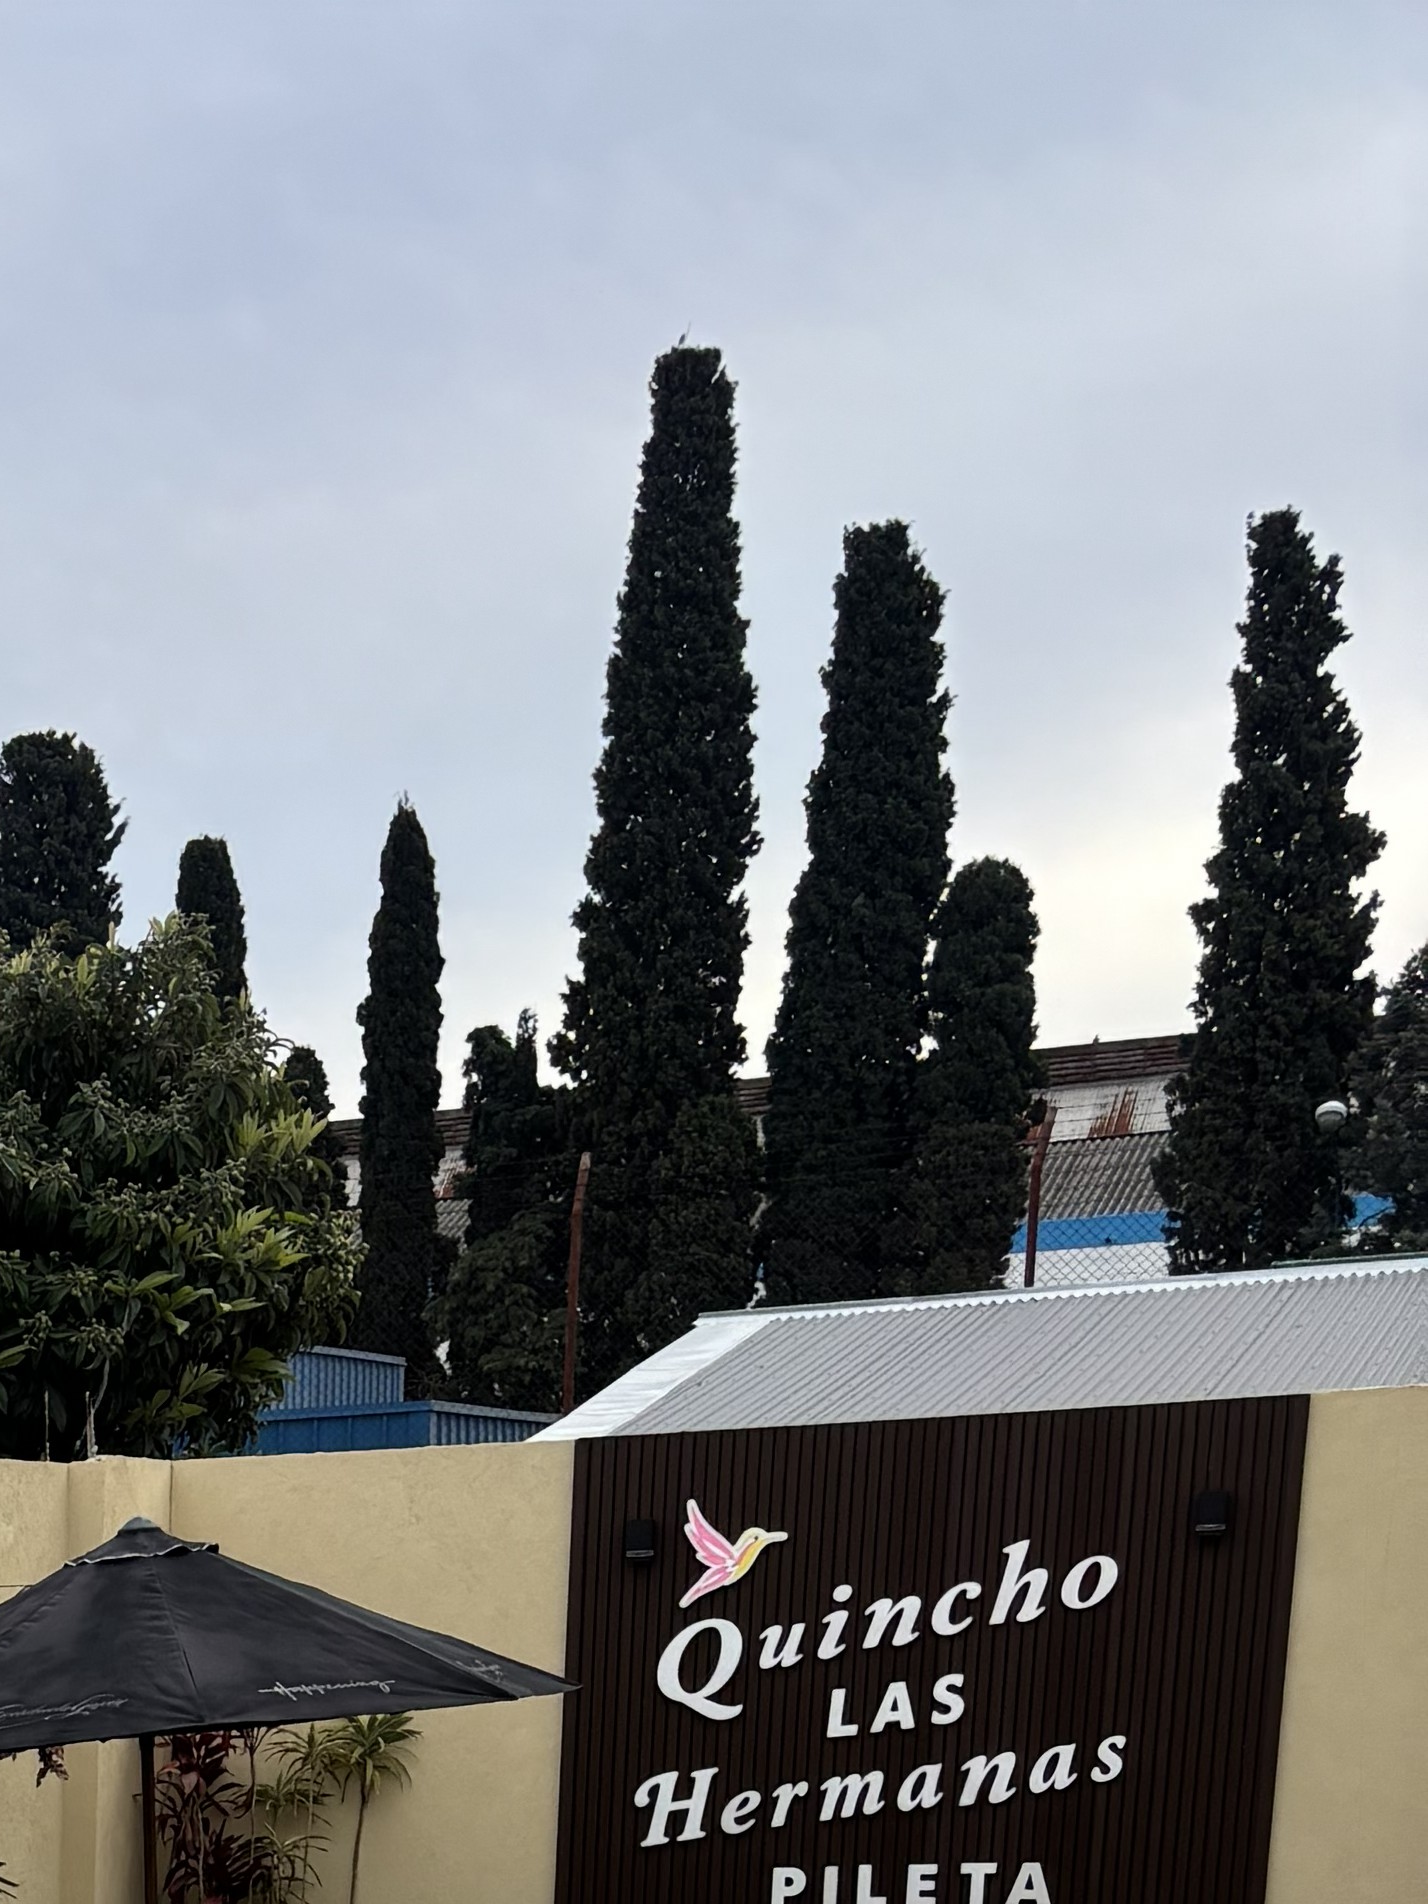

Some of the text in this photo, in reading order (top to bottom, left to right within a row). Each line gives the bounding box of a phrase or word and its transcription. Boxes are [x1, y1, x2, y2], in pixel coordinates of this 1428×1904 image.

[656, 1539, 1119, 1721] Quincho
[826, 1673, 966, 1738] LAS
[633, 1735, 1127, 1848] Hermanas
